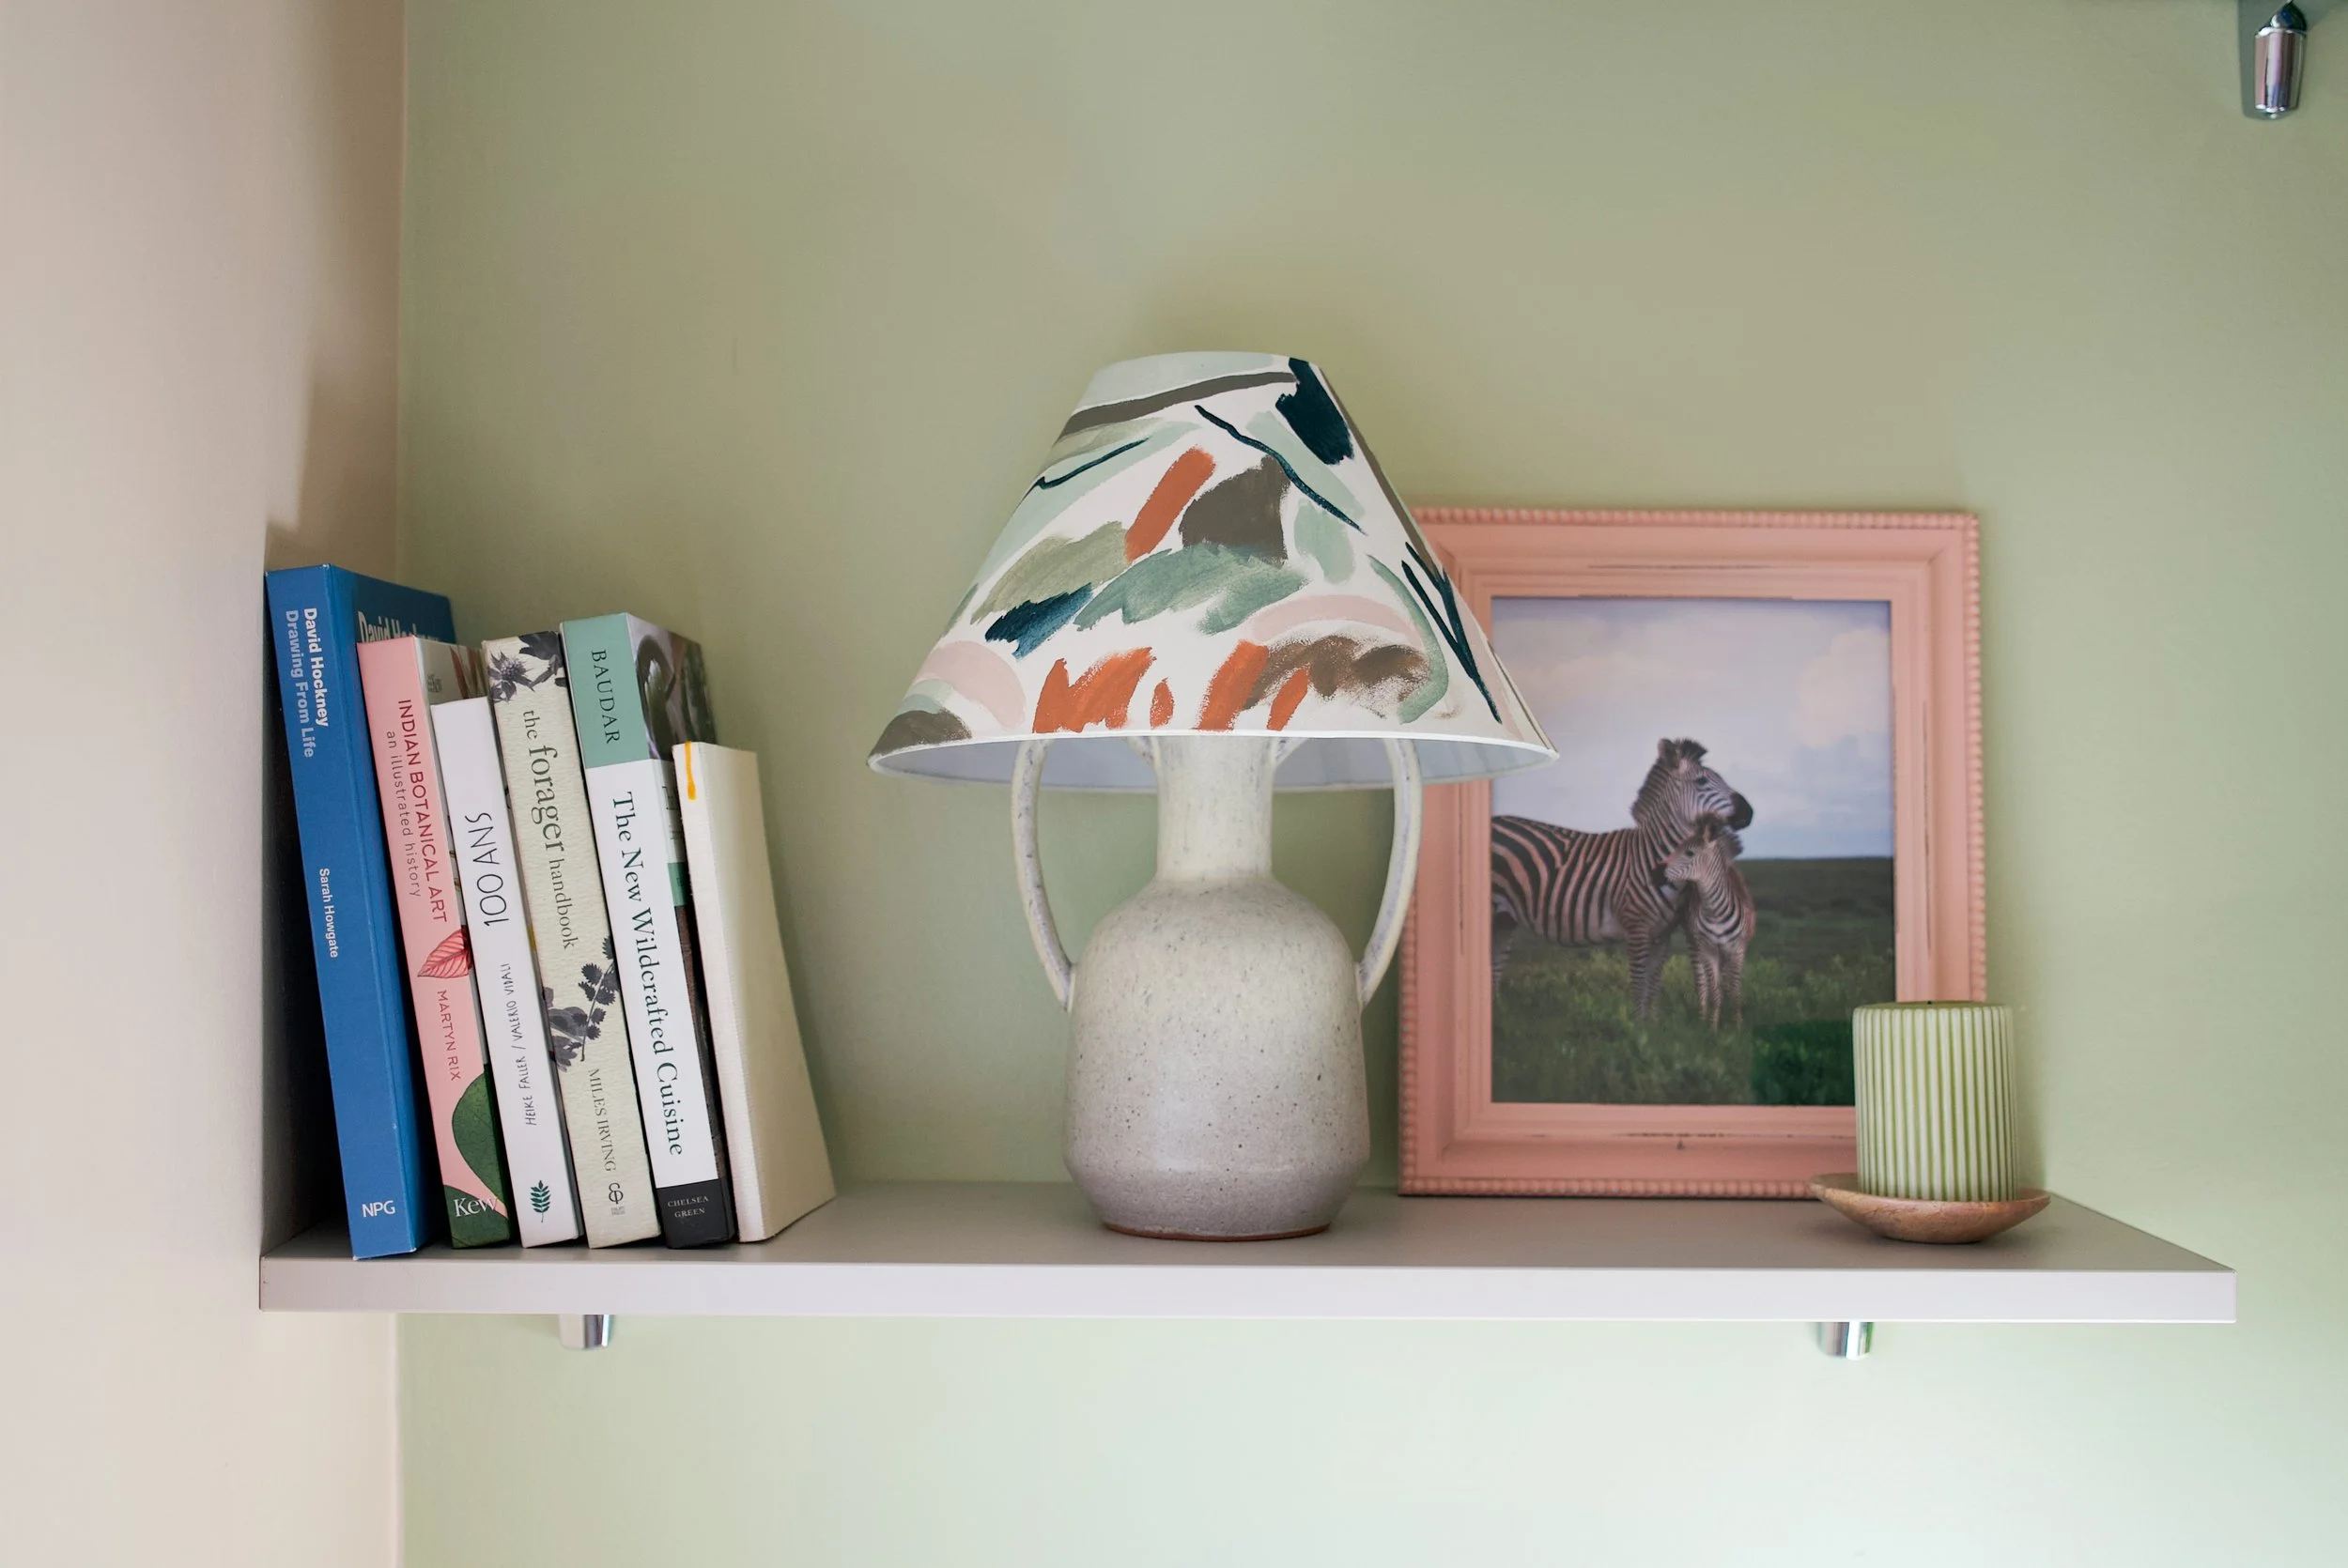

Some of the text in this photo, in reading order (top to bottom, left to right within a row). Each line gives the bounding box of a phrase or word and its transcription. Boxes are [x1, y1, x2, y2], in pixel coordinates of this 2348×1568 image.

[286, 610, 317, 758] Drawing From Life
[303, 607, 329, 727] David Hockney
[591, 649, 621, 745] BAUDAR
[386, 731, 421, 897] an illustrated history
[398, 699, 447, 922] INDIAN BOTANICAL ART
[523, 710, 579, 950] the forager handbook
[319, 868, 338, 958] Sarah Howgate
[464, 812, 509, 926] 100 ANS
[612, 792, 683, 1156] The New Wildcrafted Cuisine
[437, 990, 461, 1081] MARTYN RIX
[506, 1000, 523, 1042] VALERIO
[516, 1055, 531, 1089] FALLER
[523, 1095, 537, 1126] HEIKE
[588, 1068, 616, 1172] MILES IRVING
[363, 1200, 395, 1217] NPG
[455, 1197, 498, 1217] Kew
[667, 1195, 709, 1207] CHELSEA
[674, 1207, 705, 1218] GREEN
